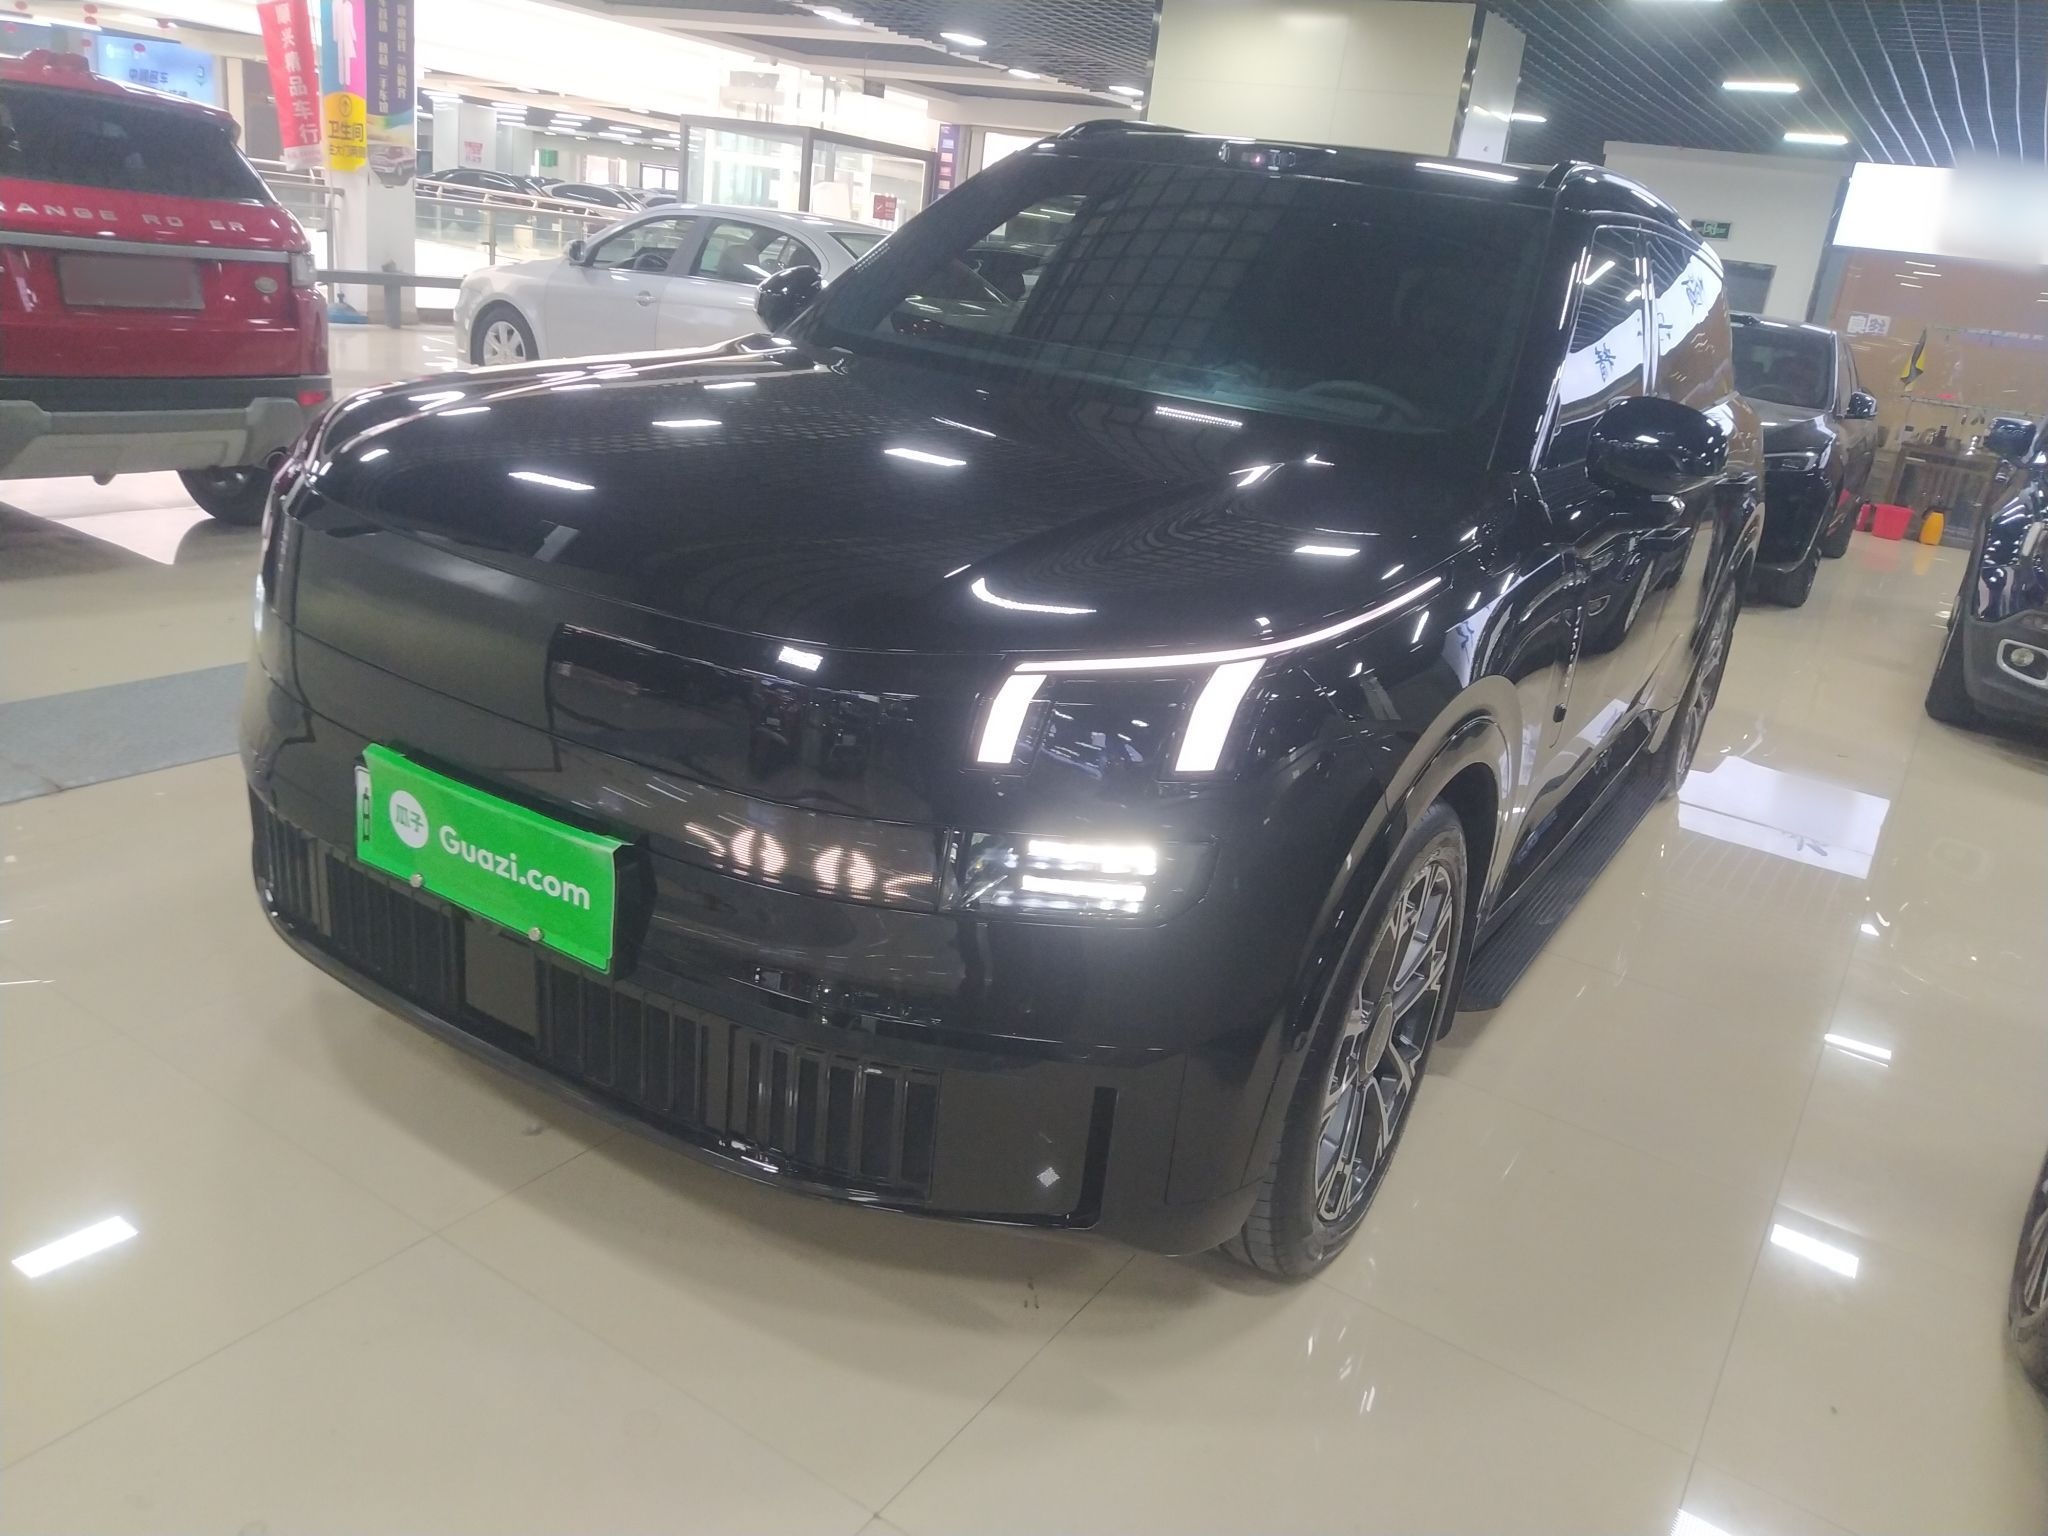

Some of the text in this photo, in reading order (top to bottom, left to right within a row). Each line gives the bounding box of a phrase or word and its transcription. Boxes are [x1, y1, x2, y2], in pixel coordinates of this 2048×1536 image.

[328, 120, 363, 142] 卫生间
[395, 803, 424, 832] 瓜子
[439, 825, 591, 911] Guazi.com
